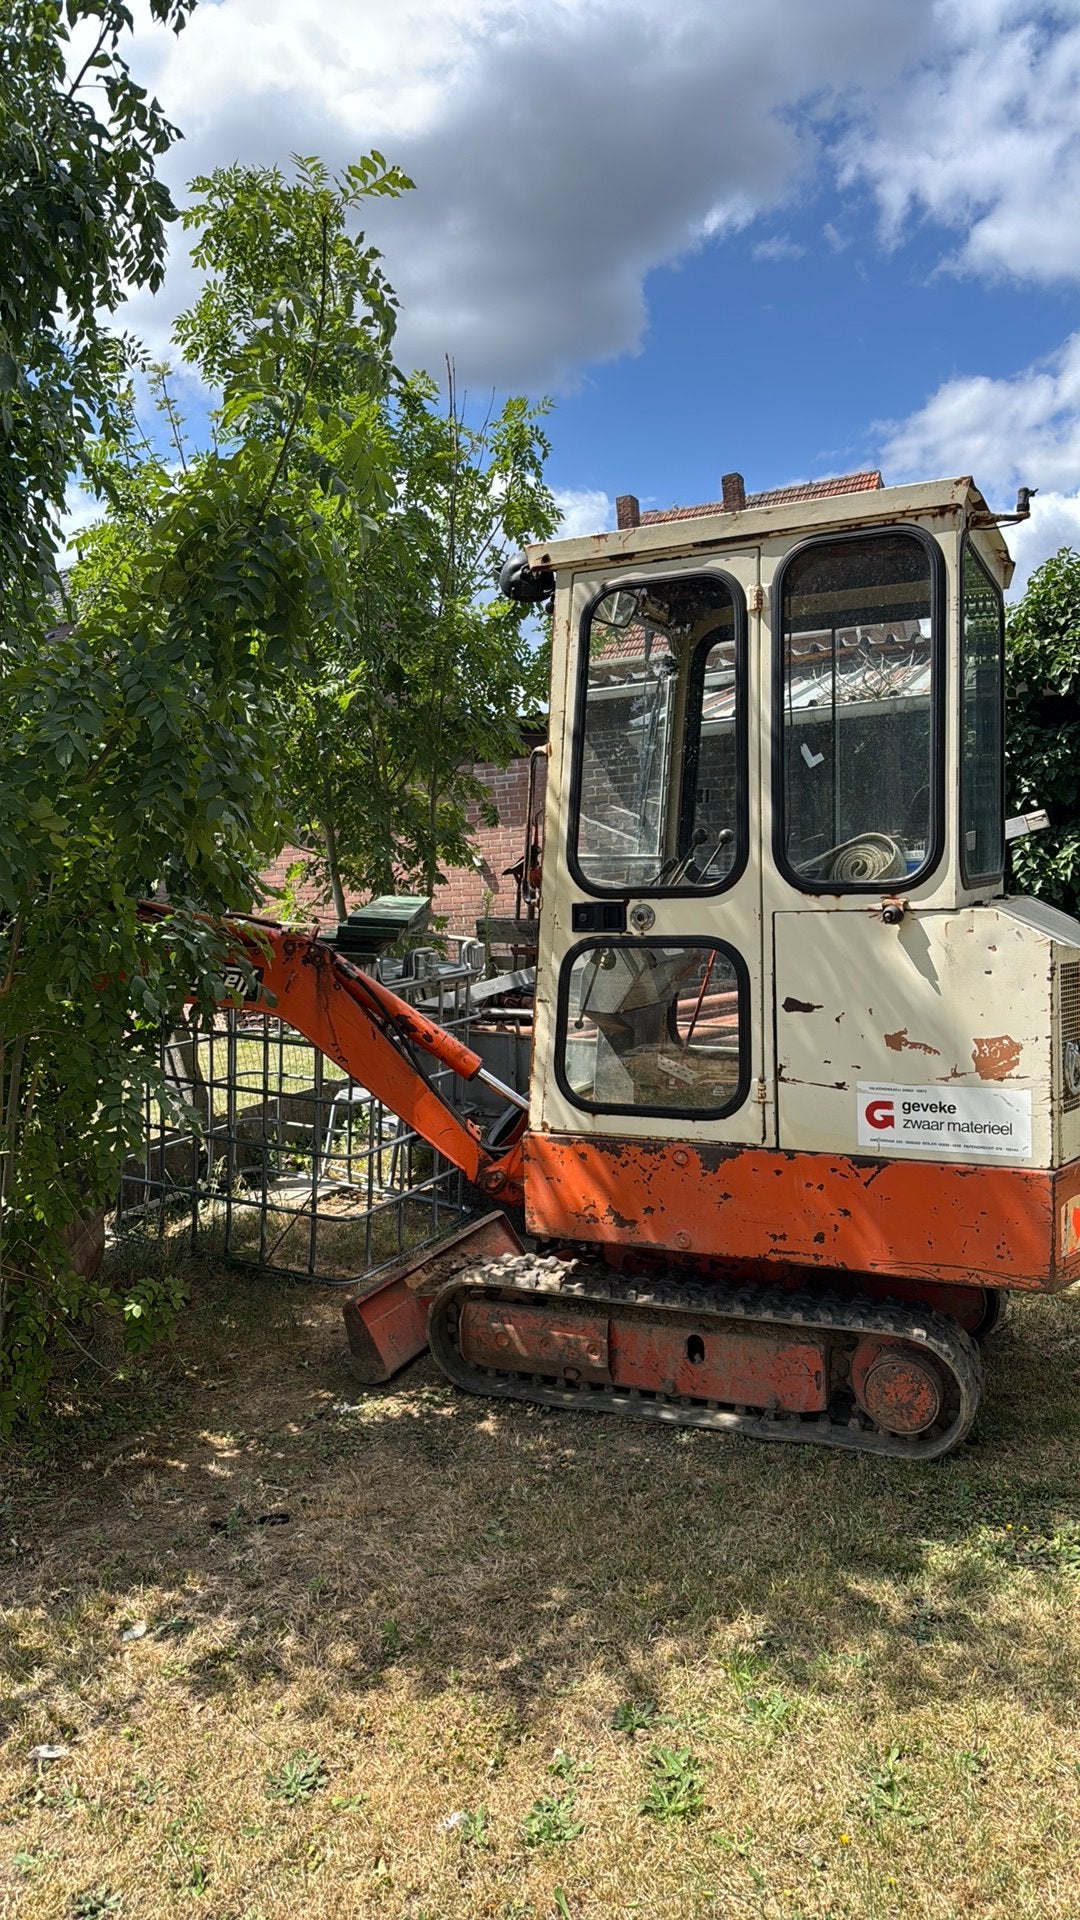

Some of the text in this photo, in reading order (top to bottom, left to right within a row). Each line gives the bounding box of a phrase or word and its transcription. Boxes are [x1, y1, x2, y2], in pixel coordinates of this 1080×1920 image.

[865, 1100, 895, 1130] G
[902, 1101, 957, 1114] geveke
[902, 1118, 1013, 1135] zwaar materieel
